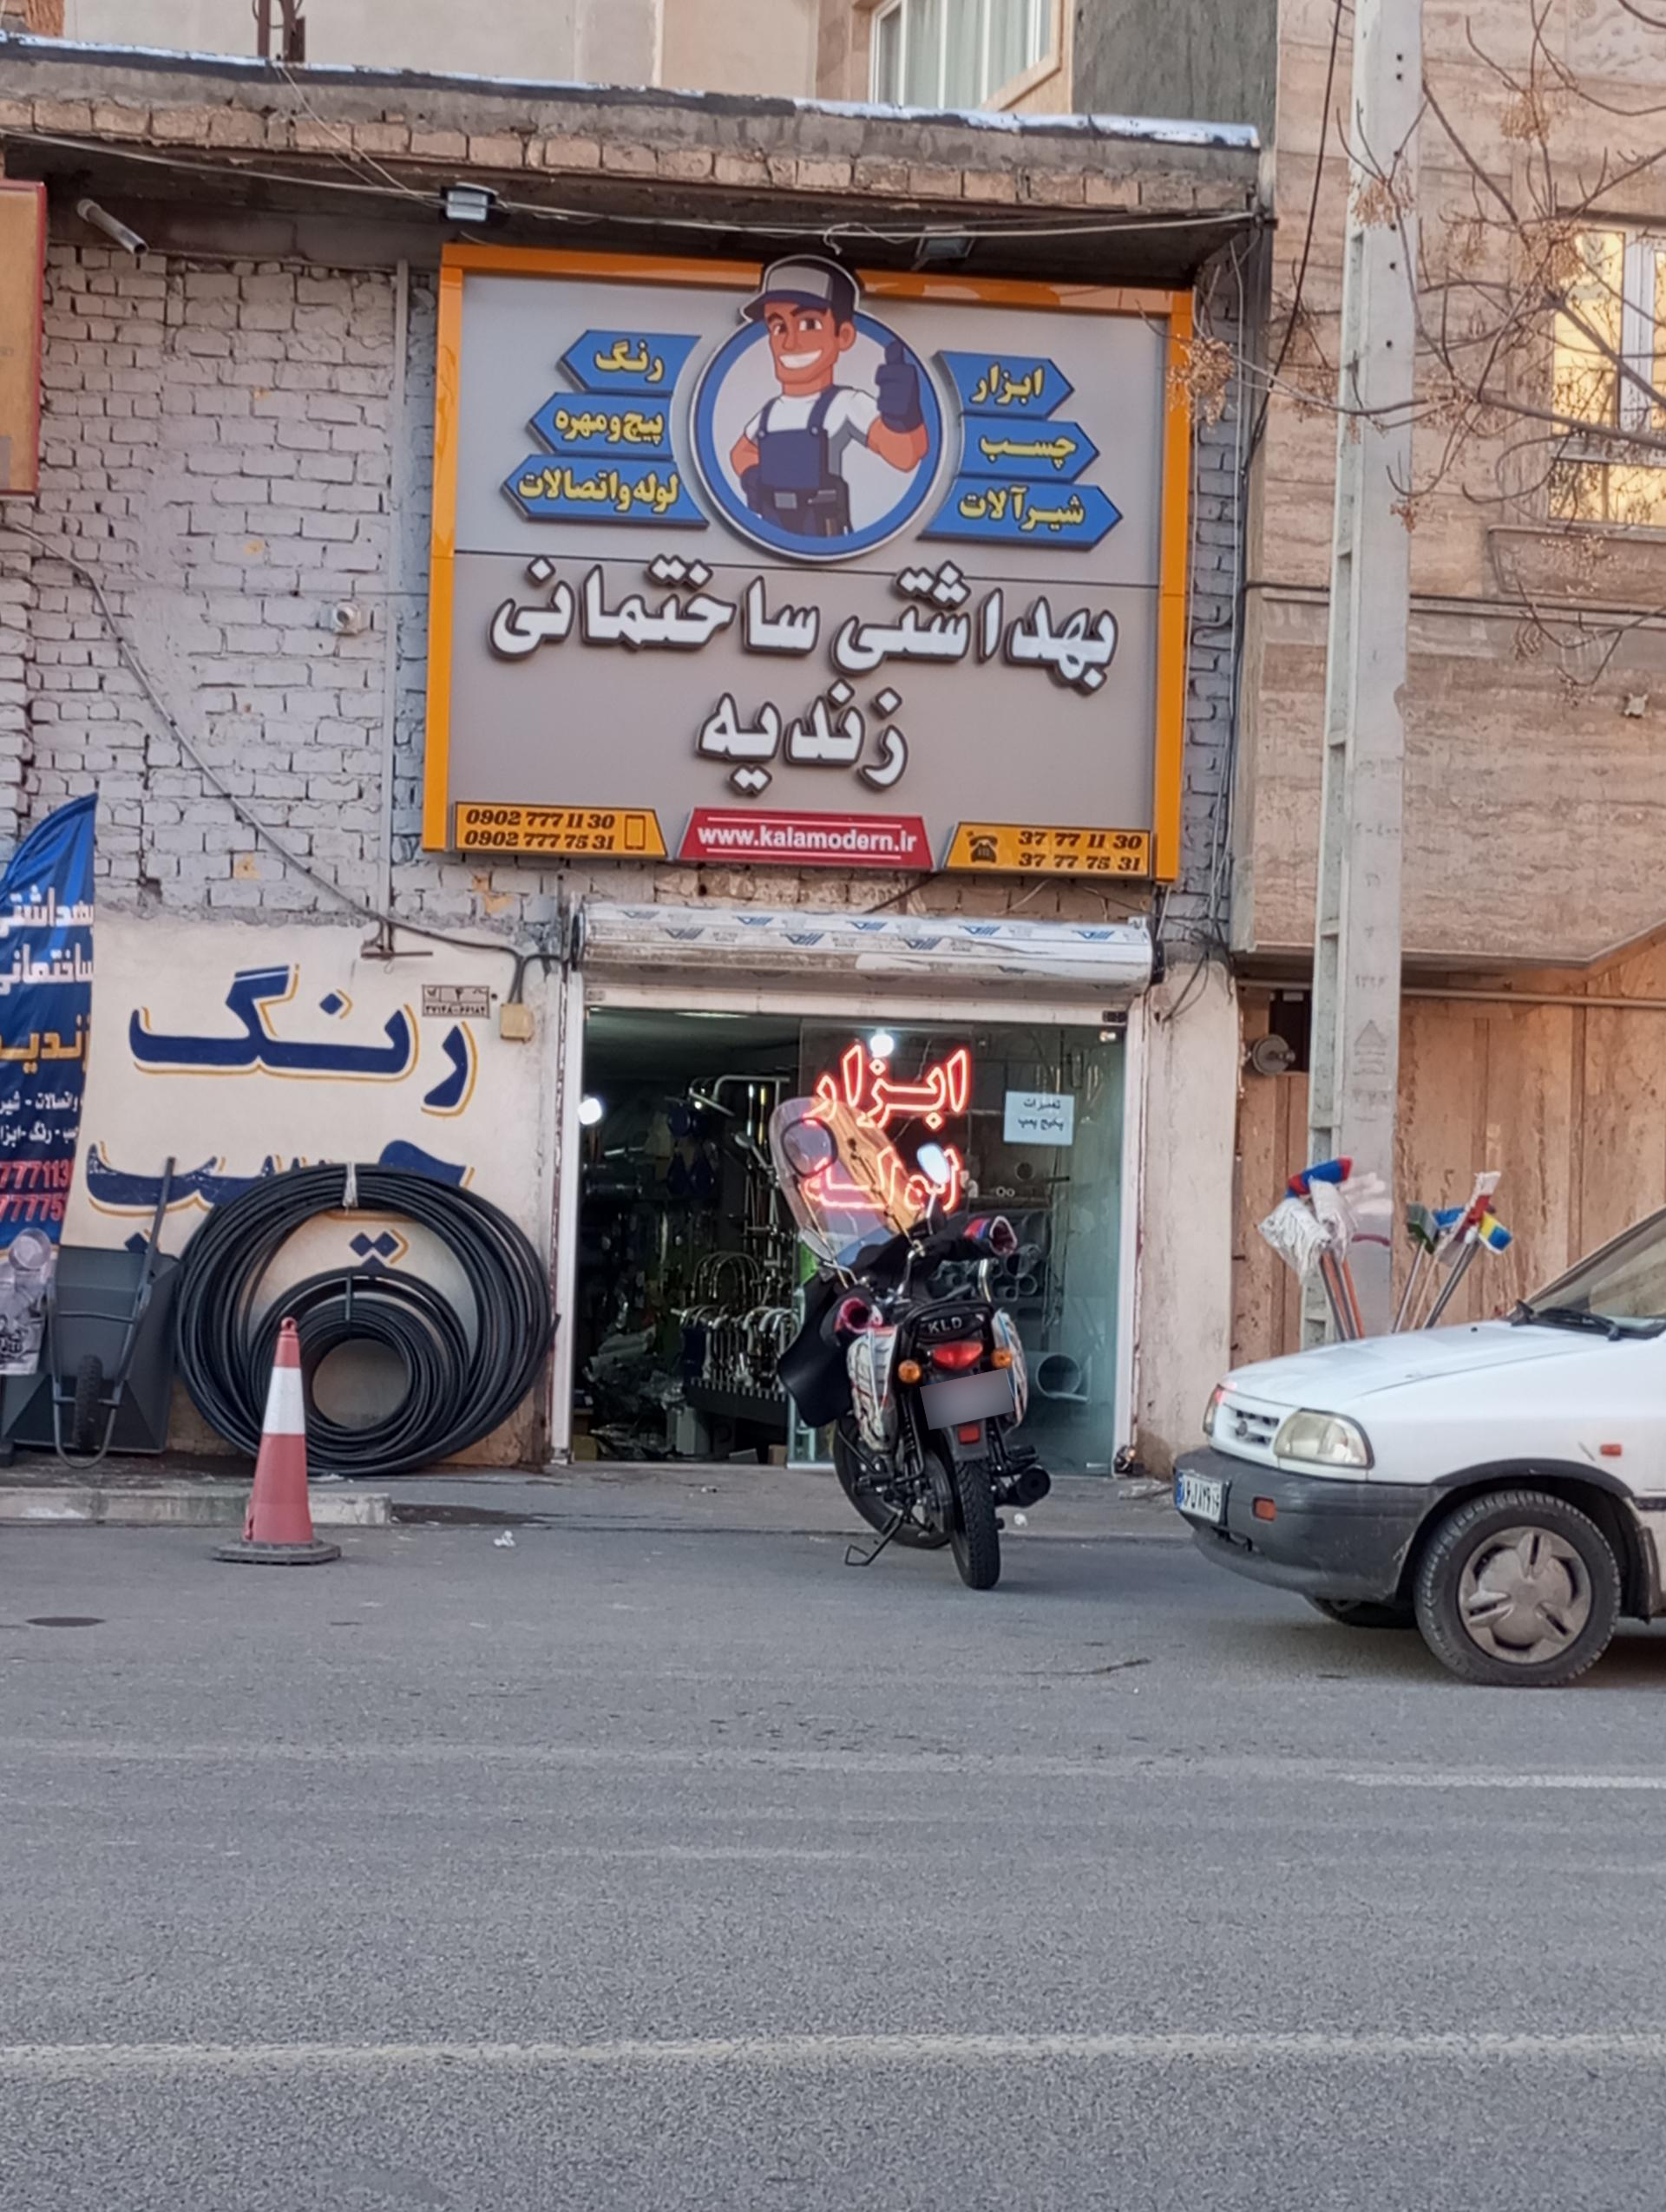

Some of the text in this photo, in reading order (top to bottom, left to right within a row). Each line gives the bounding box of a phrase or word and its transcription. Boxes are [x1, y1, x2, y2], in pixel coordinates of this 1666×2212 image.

[594, 338, 666, 383] رنگ
[970, 363, 1044, 404] ابزار
[979, 435, 1078, 470] چسب
[489, 553, 1118, 693] بهداشتی ساختمانی
[696, 678, 908, 795] زندیه
[466, 808, 615, 829] 0902 777 11 30
[464, 829, 615, 850] 0902 777 75 31
[697, 824, 917, 852] www.kalamodern.ir
[1019, 830, 1142, 849] 37 77 11 30
[1019, 853, 1141, 872] 37 77 75 31
[0, 1014, 90, 1075] زندی
[129, 964, 477, 1116] رنگ
[802, 1044, 967, 1130] ابزار
[0, 1124, 22, 1148] ابزا
[29, 1119, 53, 1145] رنگ
[0, 1158, 75, 1190] 777113
[0, 1192, 68, 1222] 77775
[928, 1316, 963, 1333] KLD
